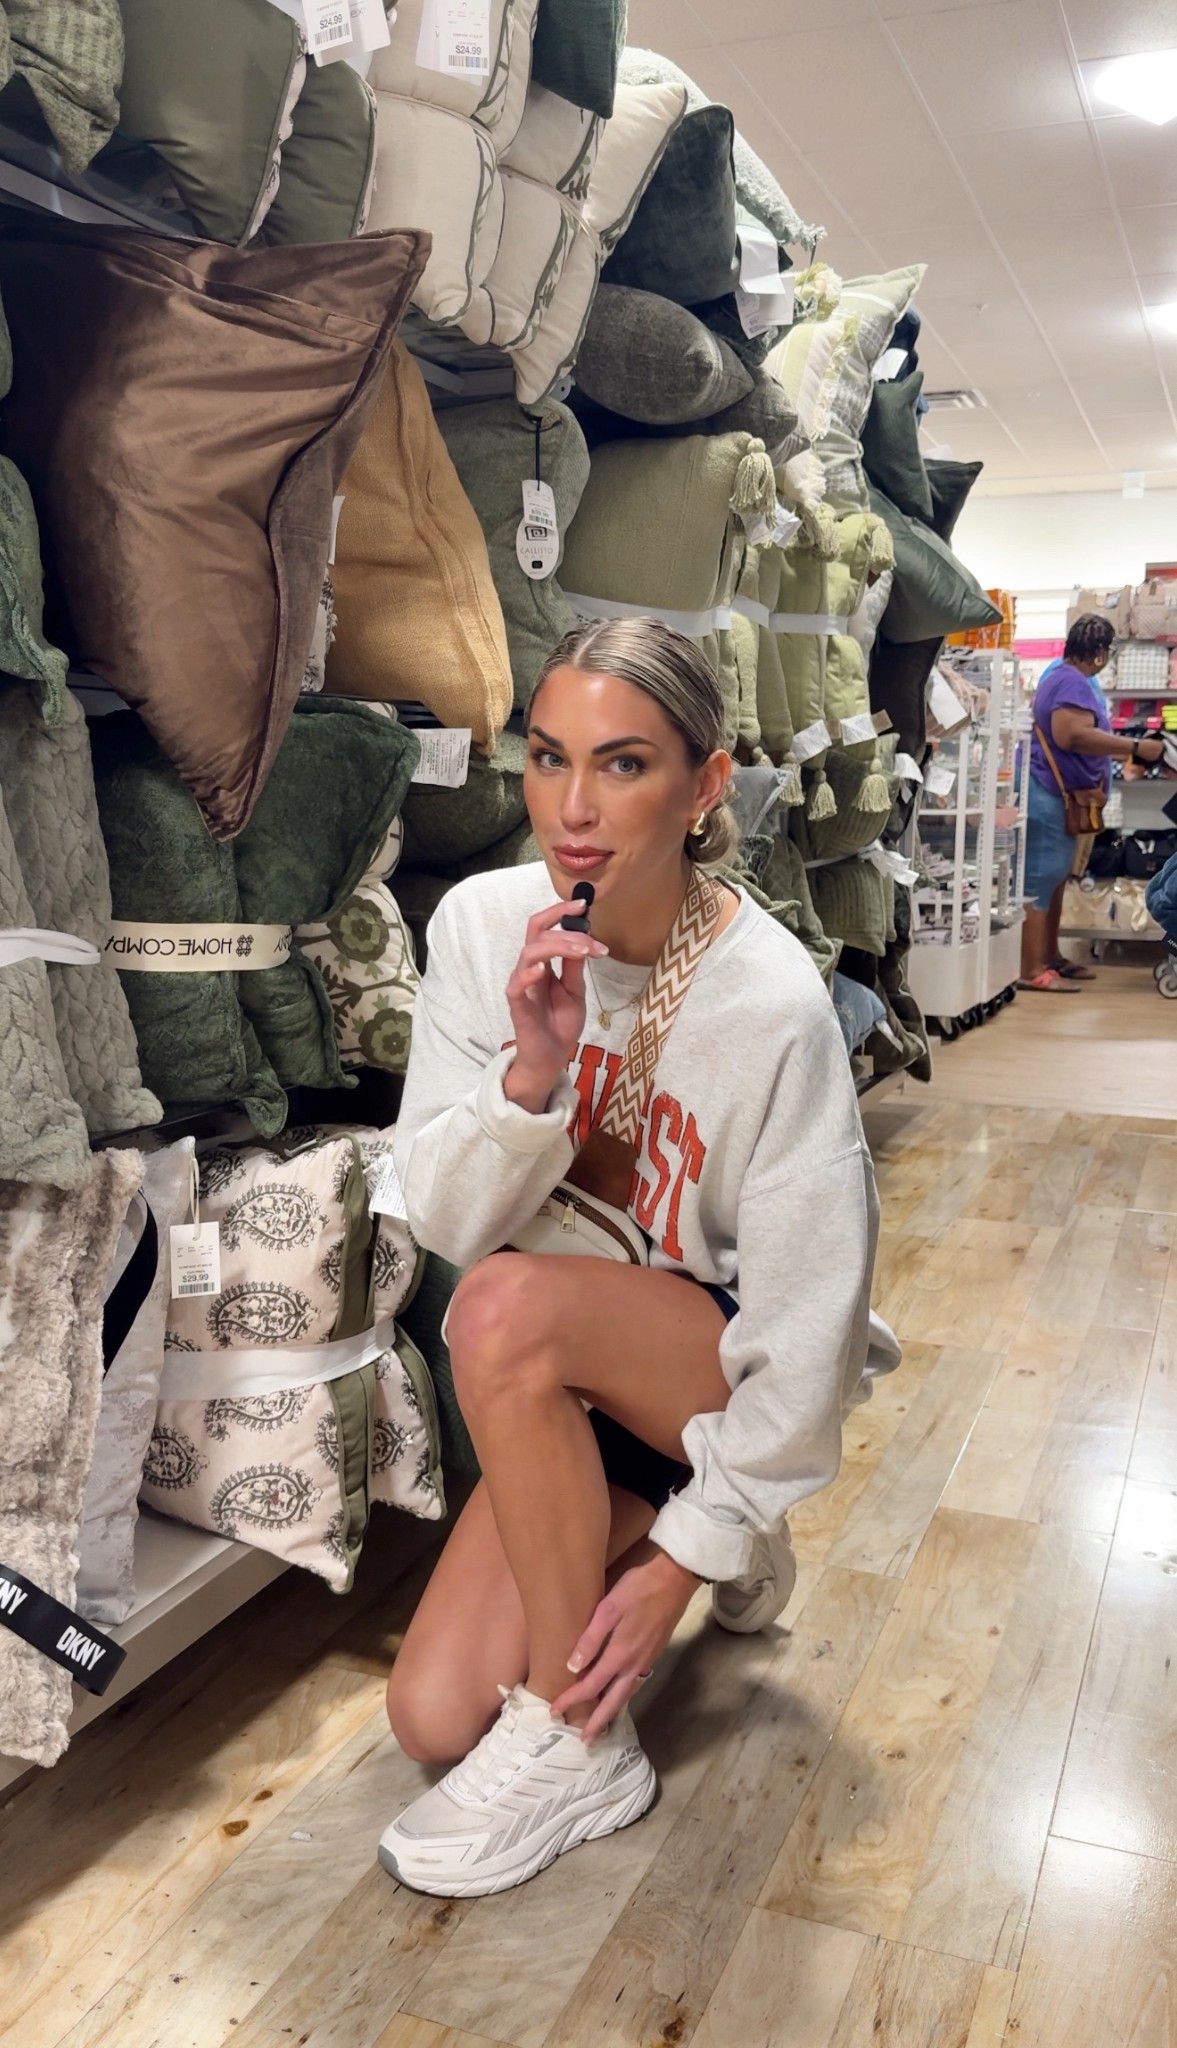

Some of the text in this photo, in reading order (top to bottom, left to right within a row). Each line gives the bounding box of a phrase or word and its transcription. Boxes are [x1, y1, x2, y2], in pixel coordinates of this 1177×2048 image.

[319, 15, 343, 29] $24.99
[455, 45, 482, 56] $24.99
[520, 547, 554, 555] CALLISTO
[177, 938, 232, 956] HOME
[182, 1273, 209, 1283] $29.99
[55, 1625, 106, 1671] DKNY
